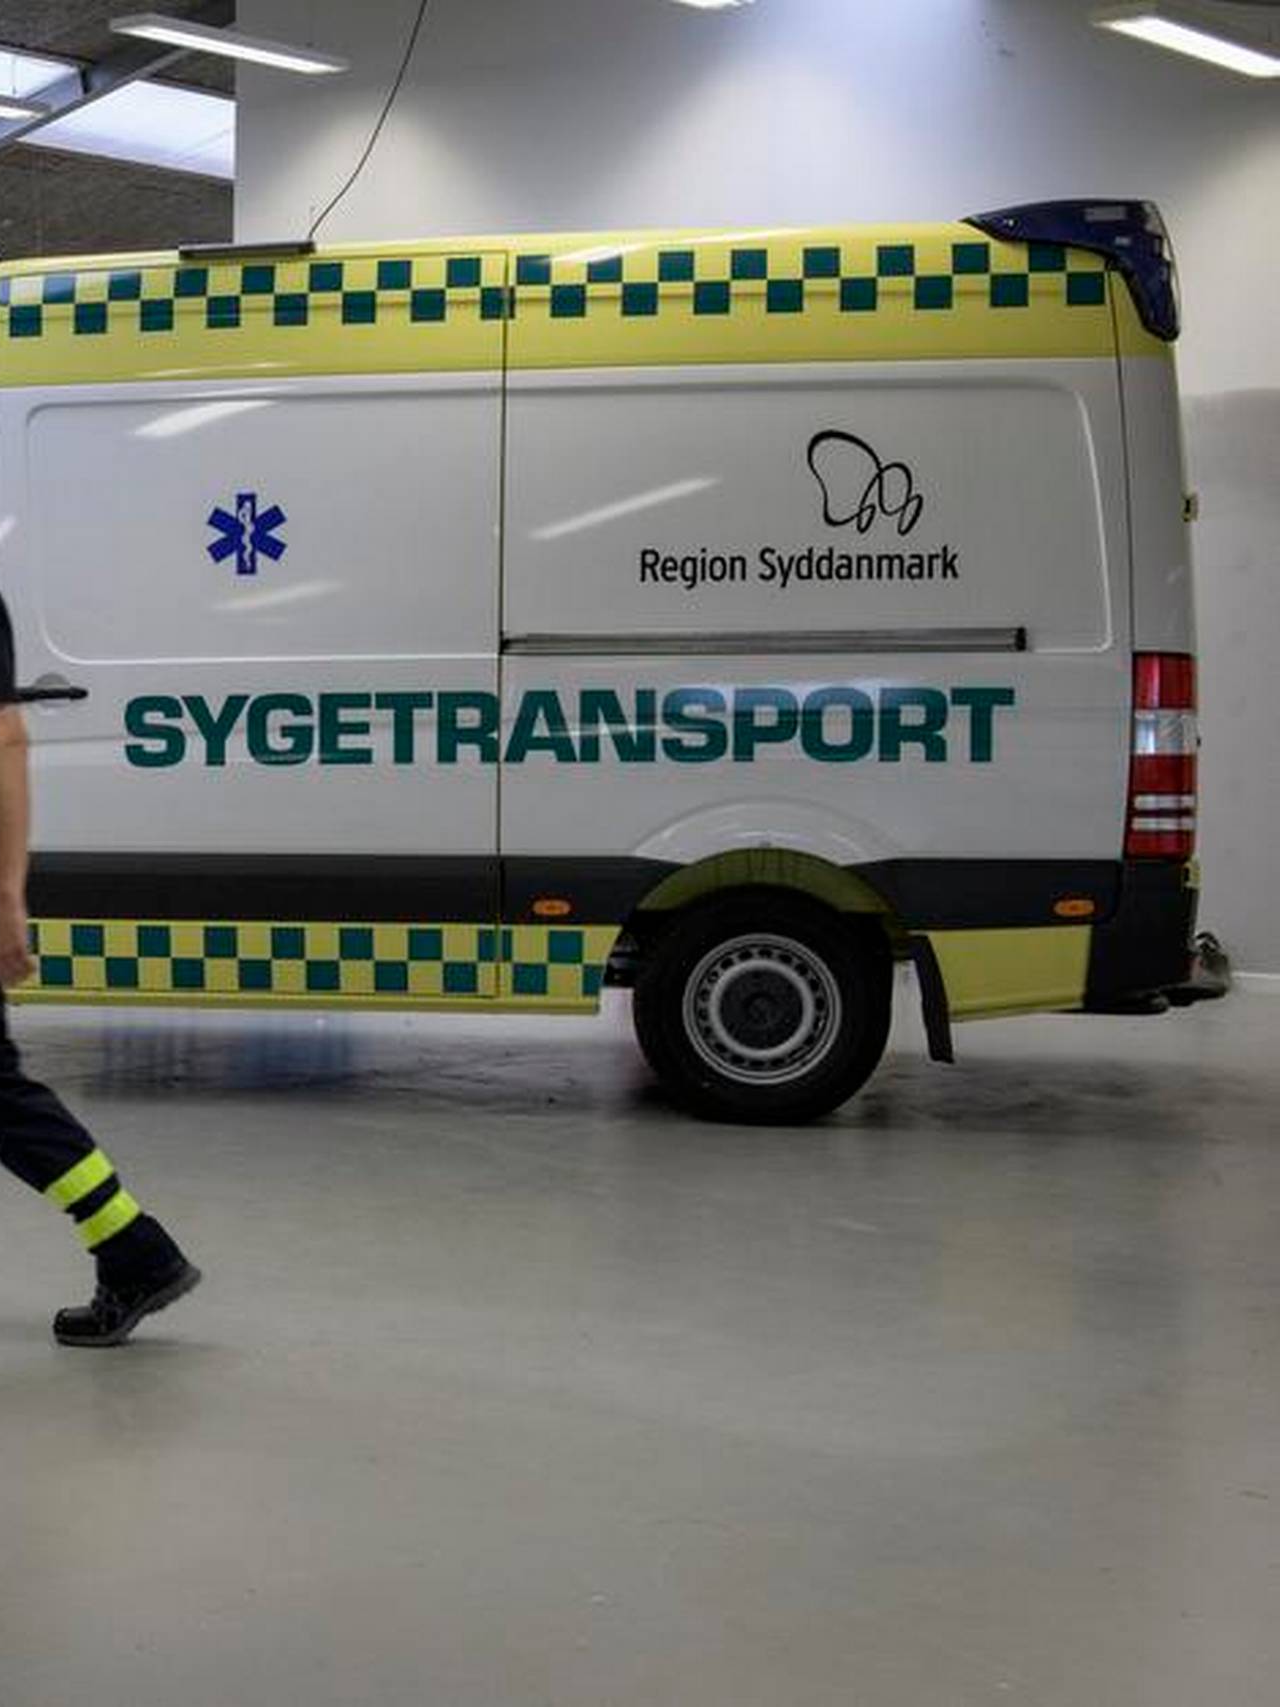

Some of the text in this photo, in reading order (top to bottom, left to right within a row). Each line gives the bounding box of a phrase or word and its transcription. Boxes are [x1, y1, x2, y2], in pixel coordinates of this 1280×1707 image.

[639, 545, 960, 590] Region Syddanmark
[123, 687, 1016, 768] SYGETRANSPORT
